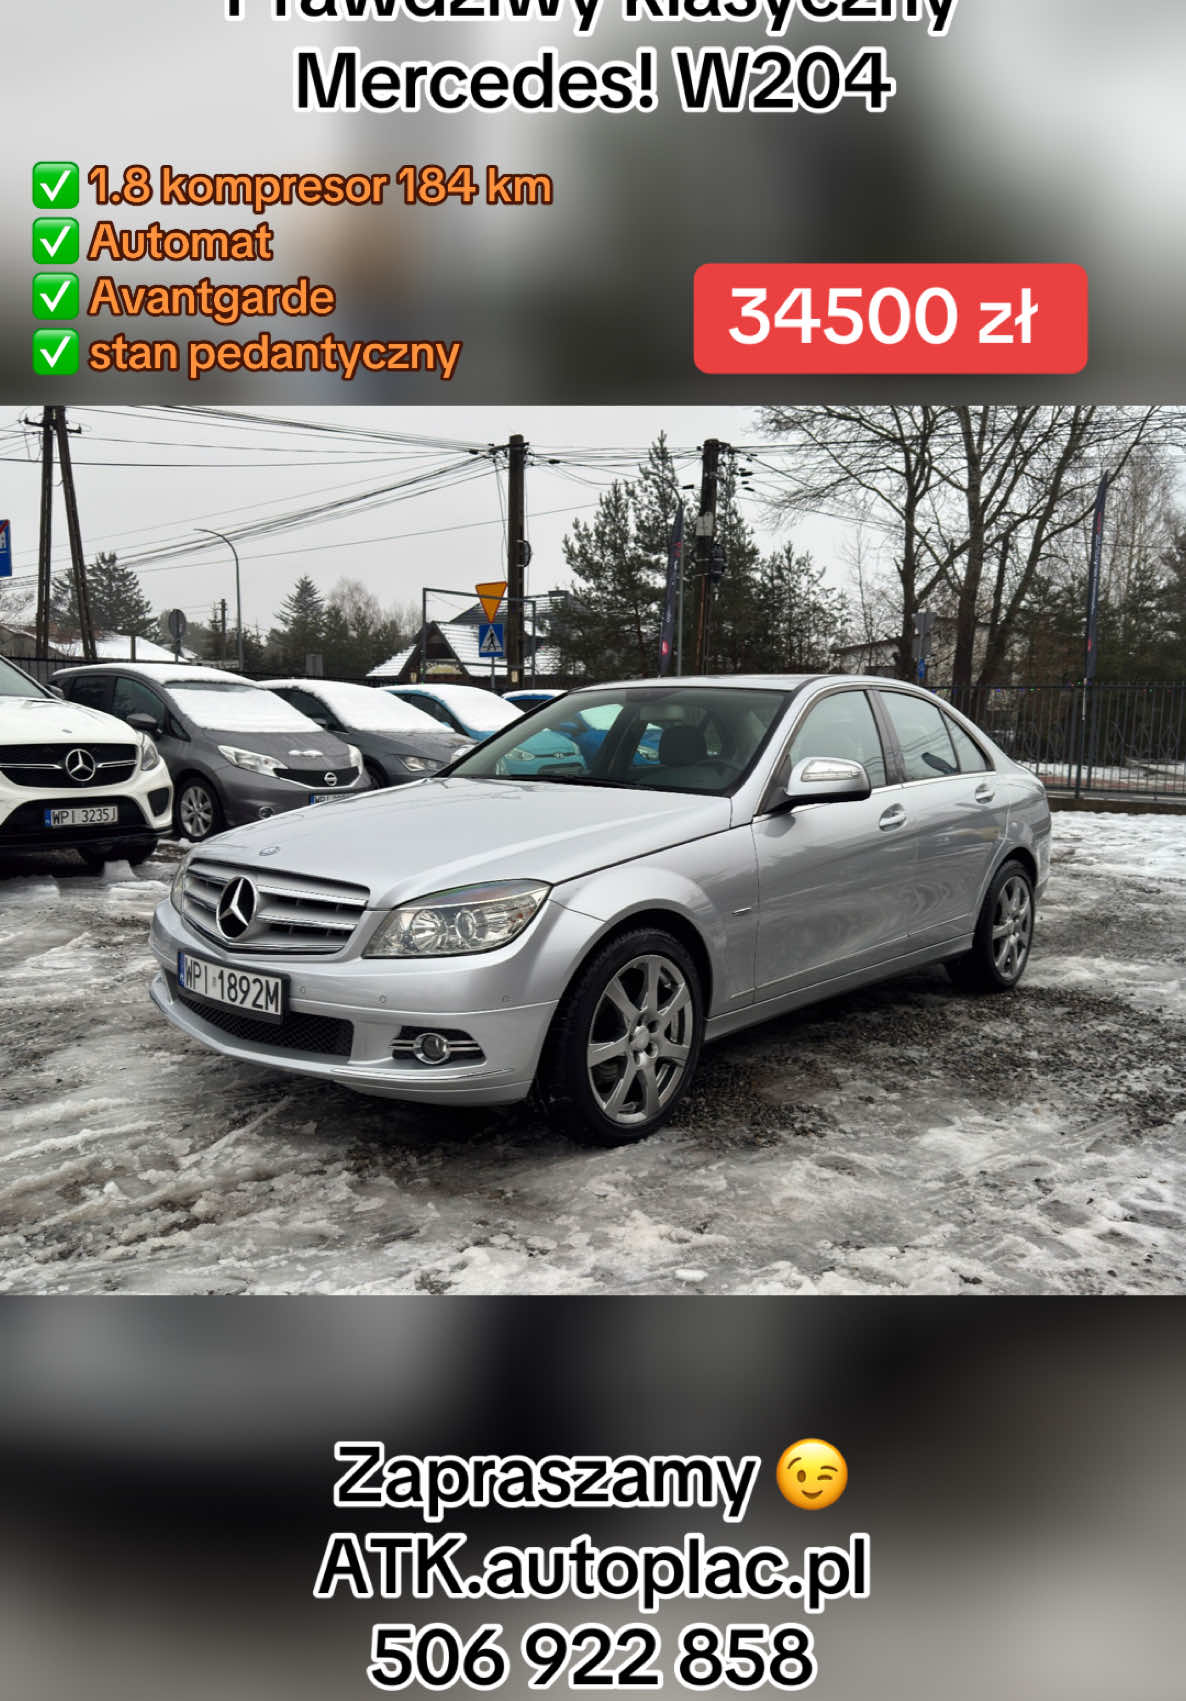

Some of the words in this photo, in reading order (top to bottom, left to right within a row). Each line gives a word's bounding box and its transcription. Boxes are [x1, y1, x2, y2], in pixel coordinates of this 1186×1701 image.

[51, 810, 75, 825] WPI
[81, 807, 116, 823] 3235J
[185, 957, 208, 995] WPI
[218, 969, 280, 1013] 1892M
